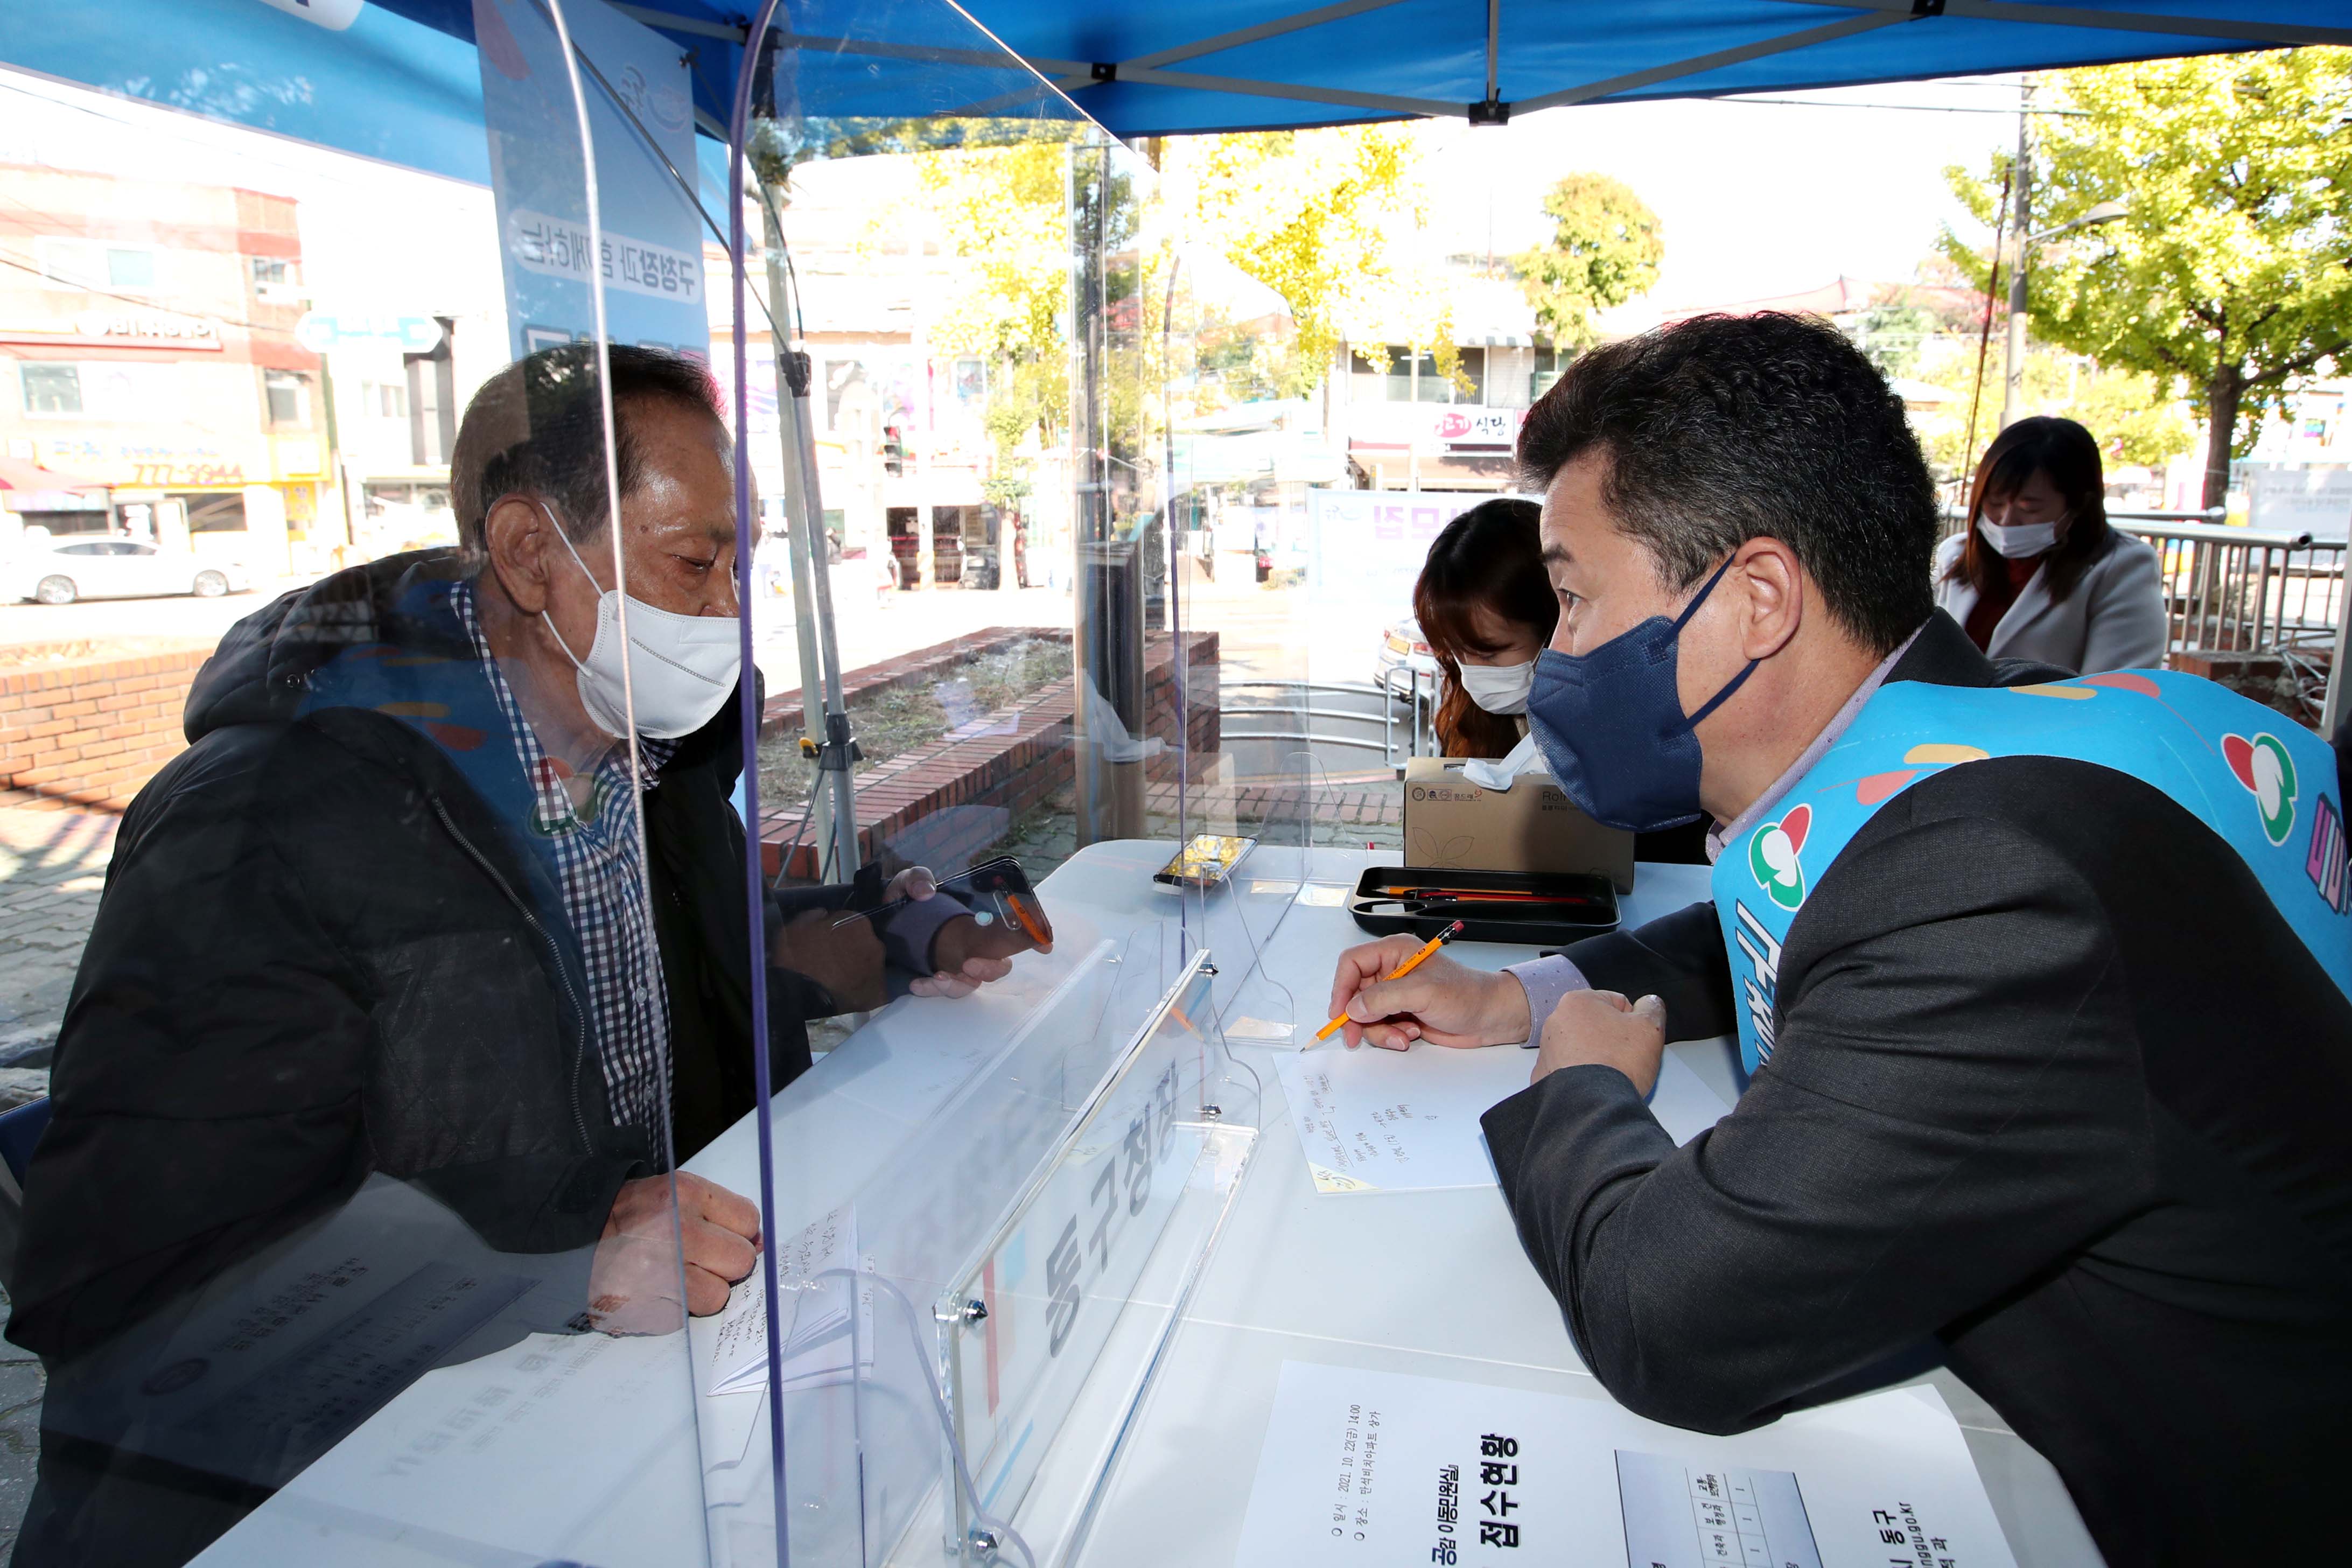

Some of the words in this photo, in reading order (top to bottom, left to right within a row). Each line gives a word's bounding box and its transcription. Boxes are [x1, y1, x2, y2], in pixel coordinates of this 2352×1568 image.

[1476, 416, 1506, 436] 식당
[1046, 1058, 1178, 1358] 동구청장
[1348, 1404, 1361, 1424] 14:00
[1368, 1411, 1381, 1428] 상가
[1344, 1427, 1359, 1452] 22(금)
[1341, 1456, 1354, 1467] 10.
[1359, 1432, 1377, 1495] 만석비치아파트
[1338, 1472, 1352, 1492] 2021.
[1480, 1433, 1520, 1549] 접수현황
[1333, 1503, 1347, 1522] 일시
[1354, 1507, 1368, 1527] 장소
[1871, 1509, 1905, 1545] 동구
[1432, 1537, 1457, 1566] 공감
[1713, 1534, 1727, 1557] 건축과
